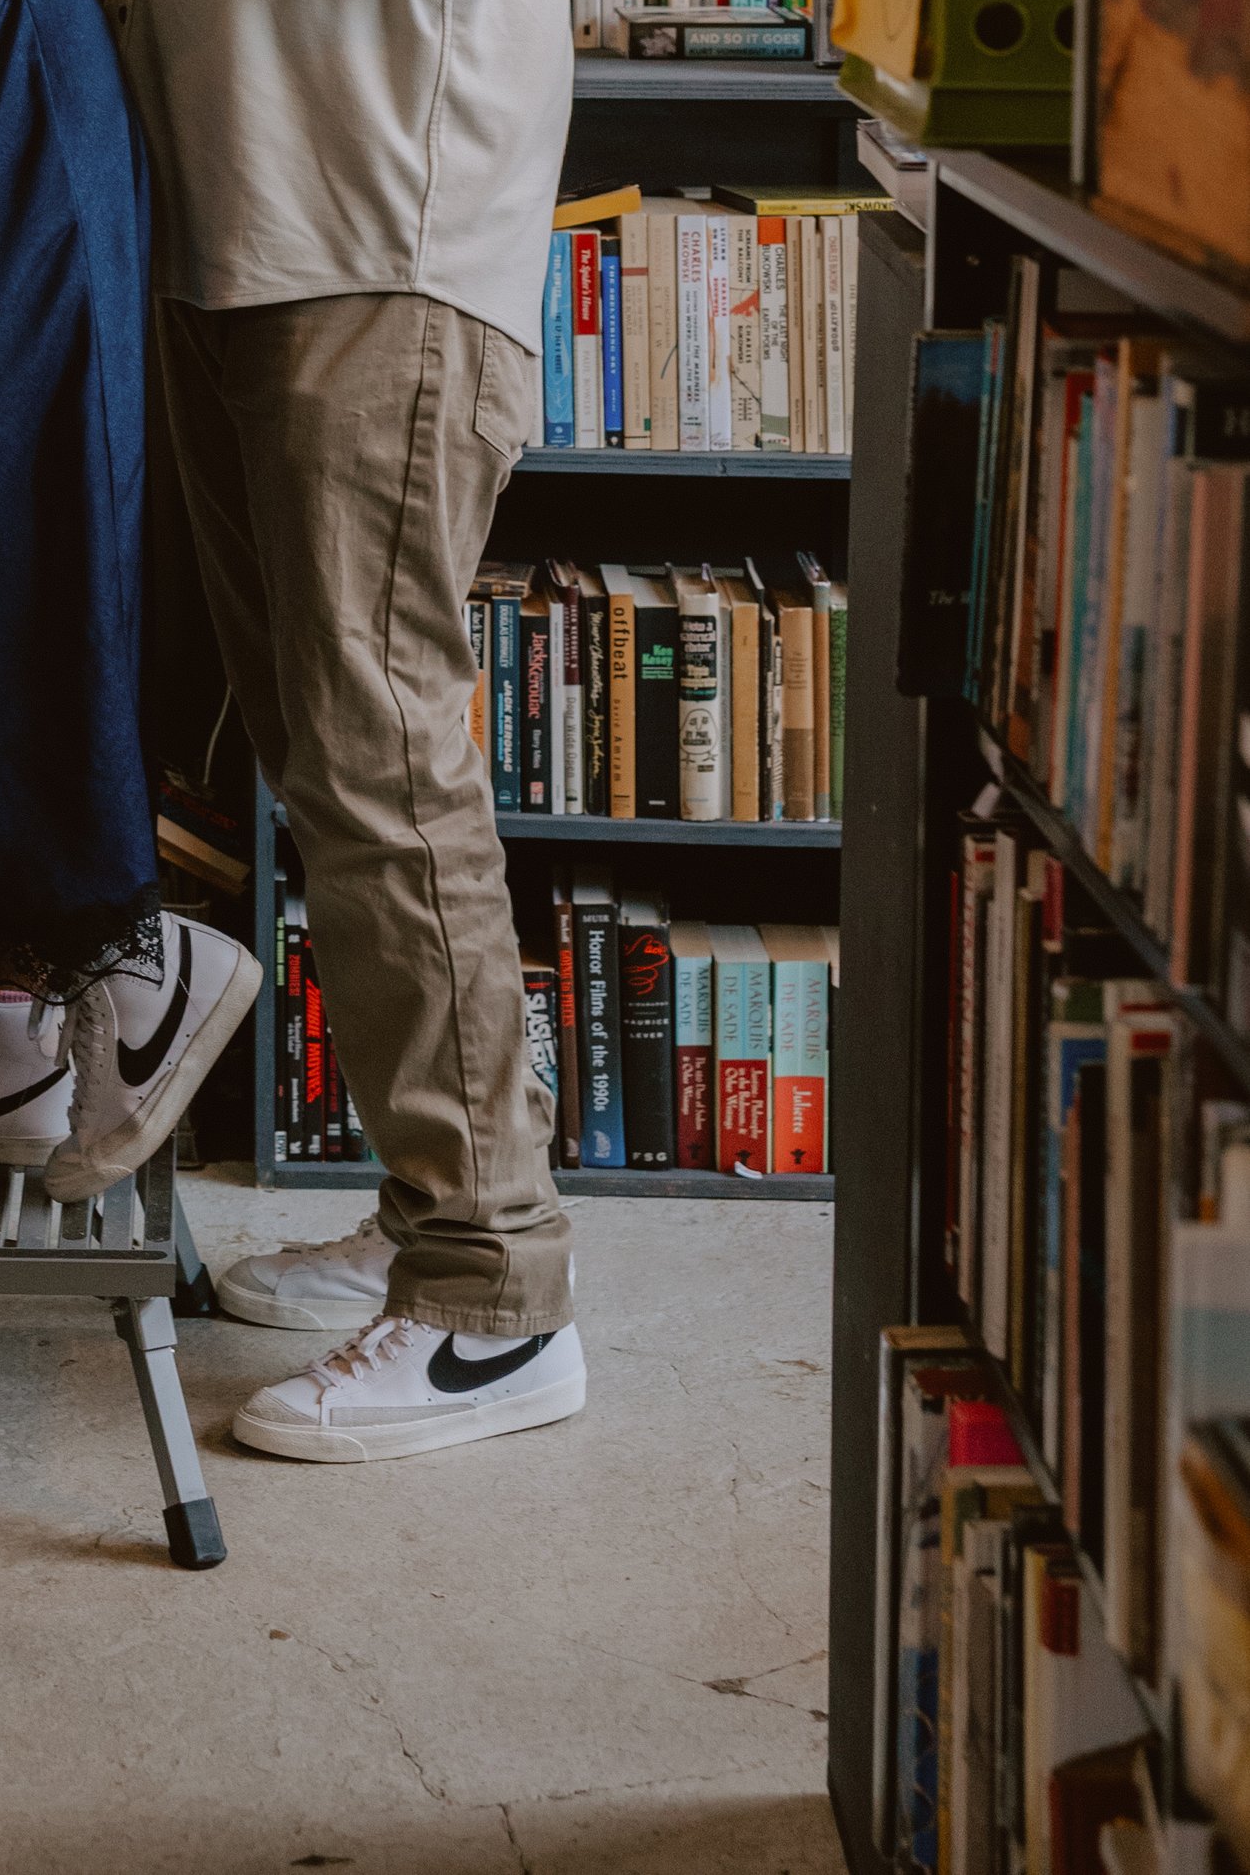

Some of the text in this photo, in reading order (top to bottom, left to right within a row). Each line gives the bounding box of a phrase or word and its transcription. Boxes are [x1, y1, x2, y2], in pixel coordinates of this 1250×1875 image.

[689, 32, 800, 45] AND SO IT GOES
[681, 231, 689, 284] BUKOWSKI
[691, 231, 701, 283] CHARLES
[762, 245, 771, 294] BUKOWSKI
[775, 247, 785, 290] CHARLES
[828, 236, 838, 294] CHARLES BUKOWSKI
[580, 249, 592, 321] The Spider's House
[762, 308, 770, 330] EARTH
[771, 321, 778, 330] OF
[584, 378, 592, 416] BOWLES
[612, 607, 630, 680] offbeat
[641, 653, 674, 666] Kesey
[652, 644, 674, 655] Ken
[503, 680, 513, 773] JACK KEROUAC
[531, 729, 543, 768] Barry Miles
[566, 697, 577, 778] Door Wide Open
[614, 736, 623, 782] Amram
[582, 915, 610, 923] MUIR
[589, 930, 609, 1111] Horror Films of the 1990s
[680, 972, 692, 1027] DE SADE
[697, 968, 709, 1033] MARQUIS
[723, 977, 738, 1043] DE SADE
[749, 970, 763, 1049] MARQUIS
[781, 983, 796, 1053] DE SADE
[805, 978, 822, 1060] MARQUIS
[306, 978, 323, 1103] ZOMBIE MOVIES
[792, 1087, 812, 1134] Juliette
[632, 1151, 668, 1162] FSG
